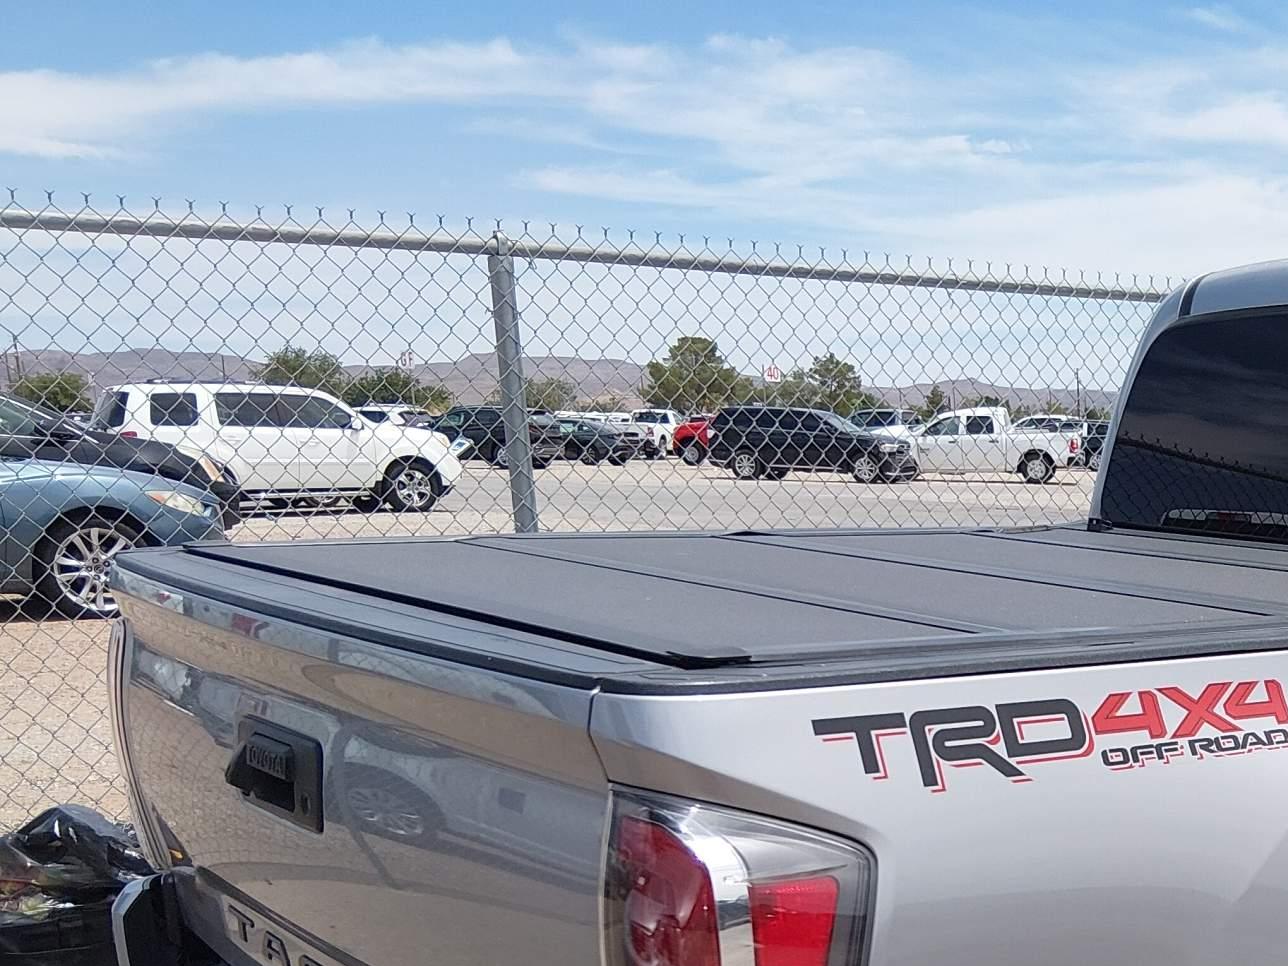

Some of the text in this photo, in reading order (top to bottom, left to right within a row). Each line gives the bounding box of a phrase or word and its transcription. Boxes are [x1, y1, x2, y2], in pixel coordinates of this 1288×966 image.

[767, 366, 779, 380] 40
[811, 698, 1095, 792] TRD
[1101, 744, 1183, 770] OFF
